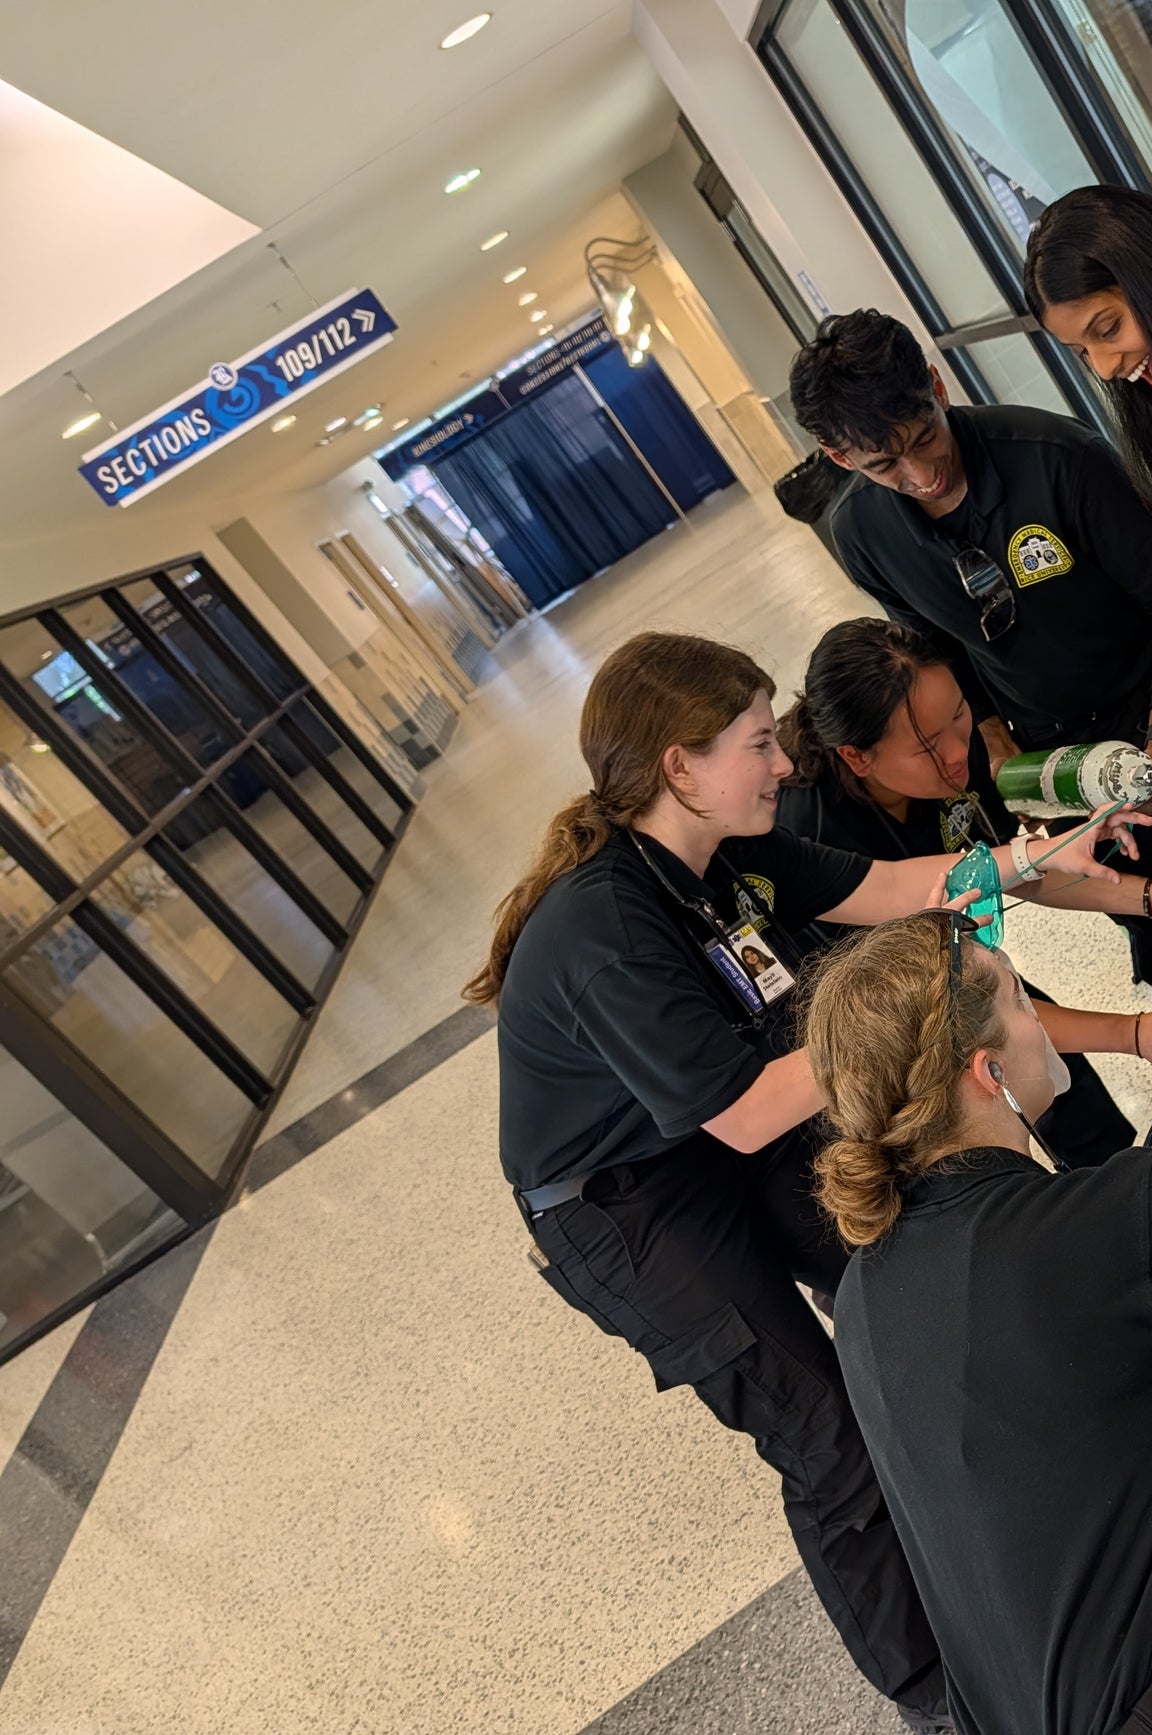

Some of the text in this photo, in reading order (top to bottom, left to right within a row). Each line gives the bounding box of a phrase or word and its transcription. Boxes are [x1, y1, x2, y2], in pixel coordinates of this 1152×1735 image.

[97, 317, 357, 494] SECTIONS 109/112
[719, 957, 738, 978] Student
[737, 977, 749, 991] EMT
